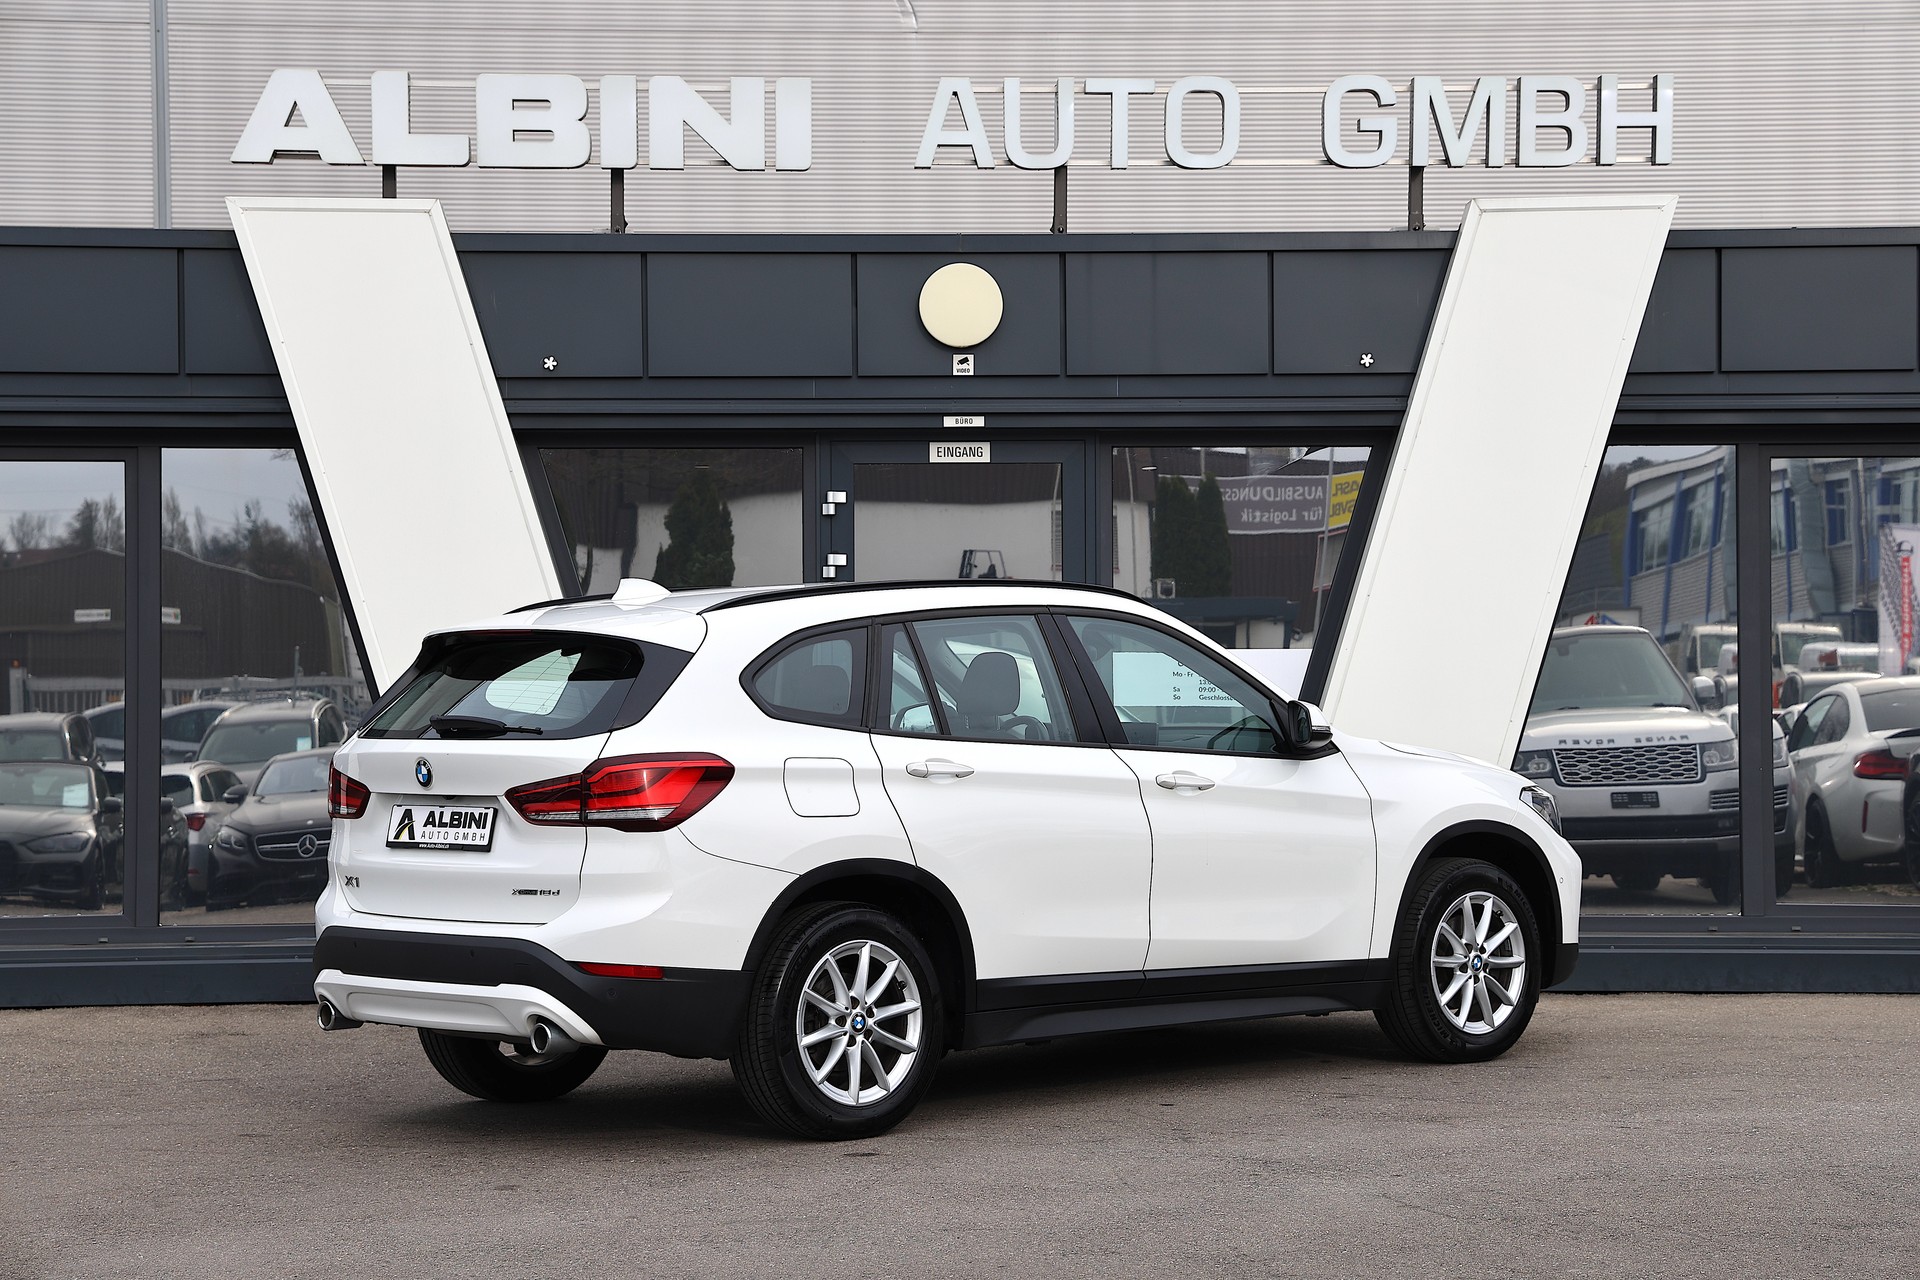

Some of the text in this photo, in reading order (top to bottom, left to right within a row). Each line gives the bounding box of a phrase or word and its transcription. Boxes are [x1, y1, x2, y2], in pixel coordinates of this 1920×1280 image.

[230, 68, 1675, 172] ALBINI AUTO GMBH
[955, 416, 973, 425] BÜRO
[936, 446, 983, 458] EINGANG
[423, 811, 488, 829] ALBINI
[421, 831, 485, 841] AUTO GMBH
[345, 875, 360, 888] X1
[1421, 984, 1450, 1039] MICHELIN
